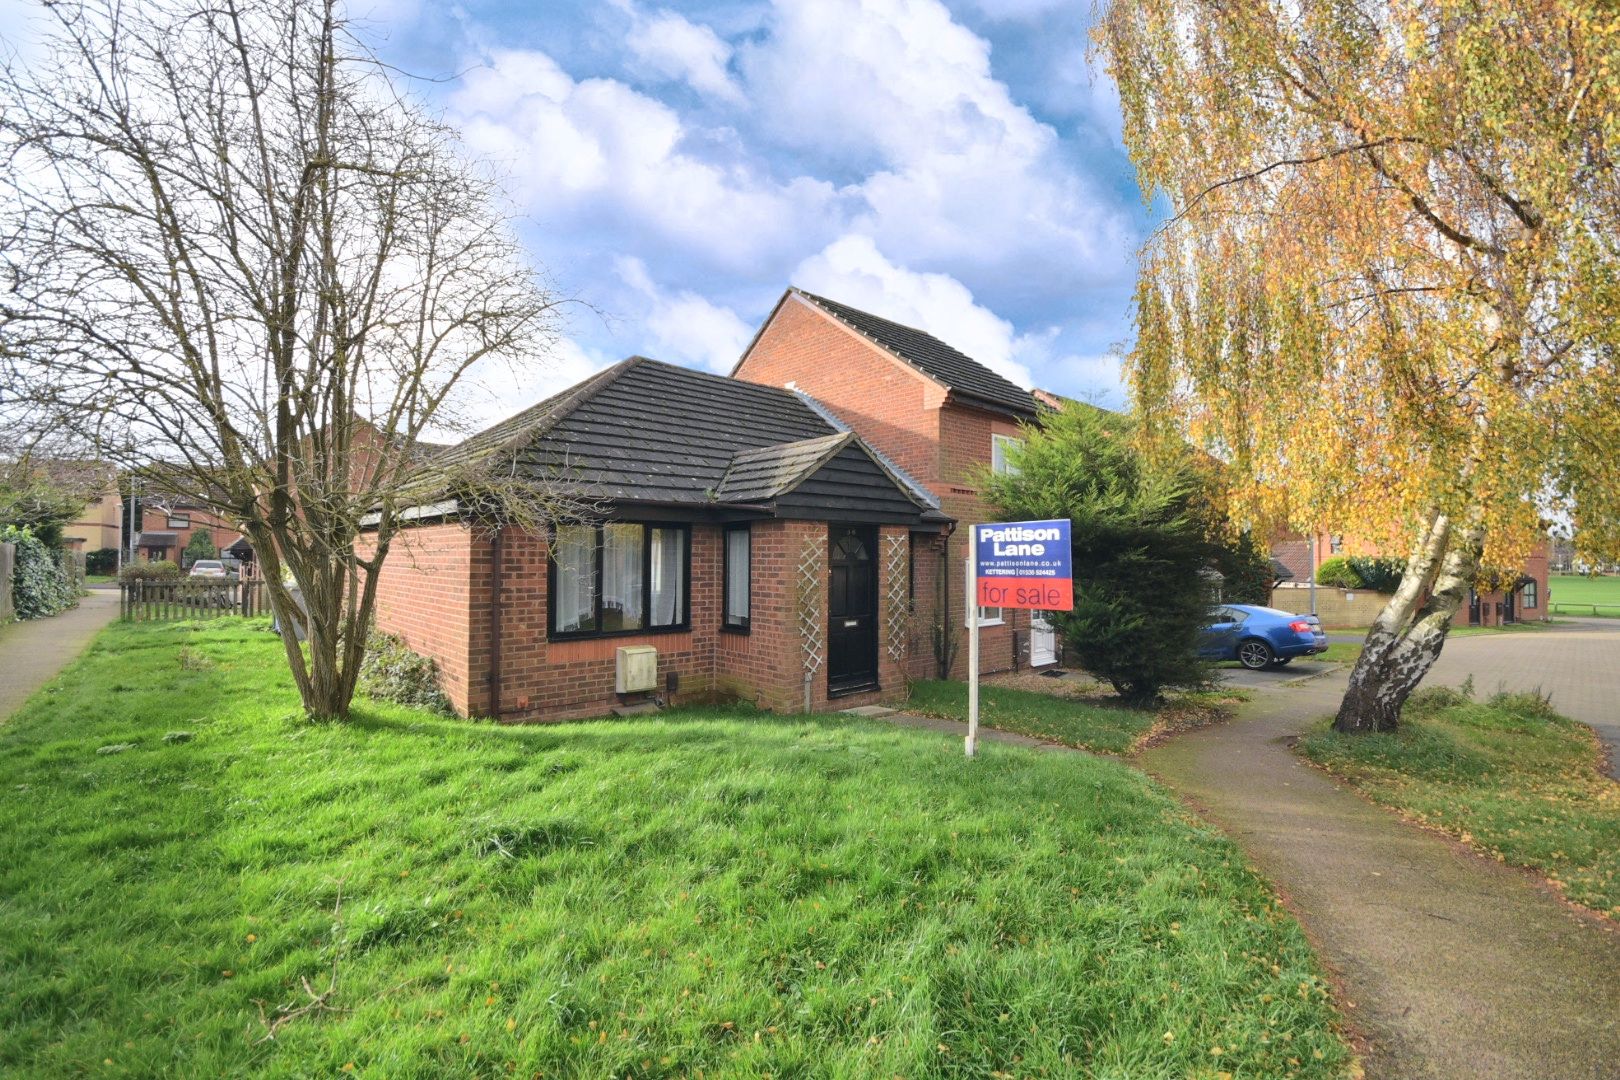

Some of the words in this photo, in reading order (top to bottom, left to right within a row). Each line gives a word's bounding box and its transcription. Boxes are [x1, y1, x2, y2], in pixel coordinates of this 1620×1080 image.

[980, 527, 1060, 542] Pattison
[994, 543, 1045, 556] Lane
[983, 582, 1008, 603] for
[1016, 584, 1060, 606] sale
